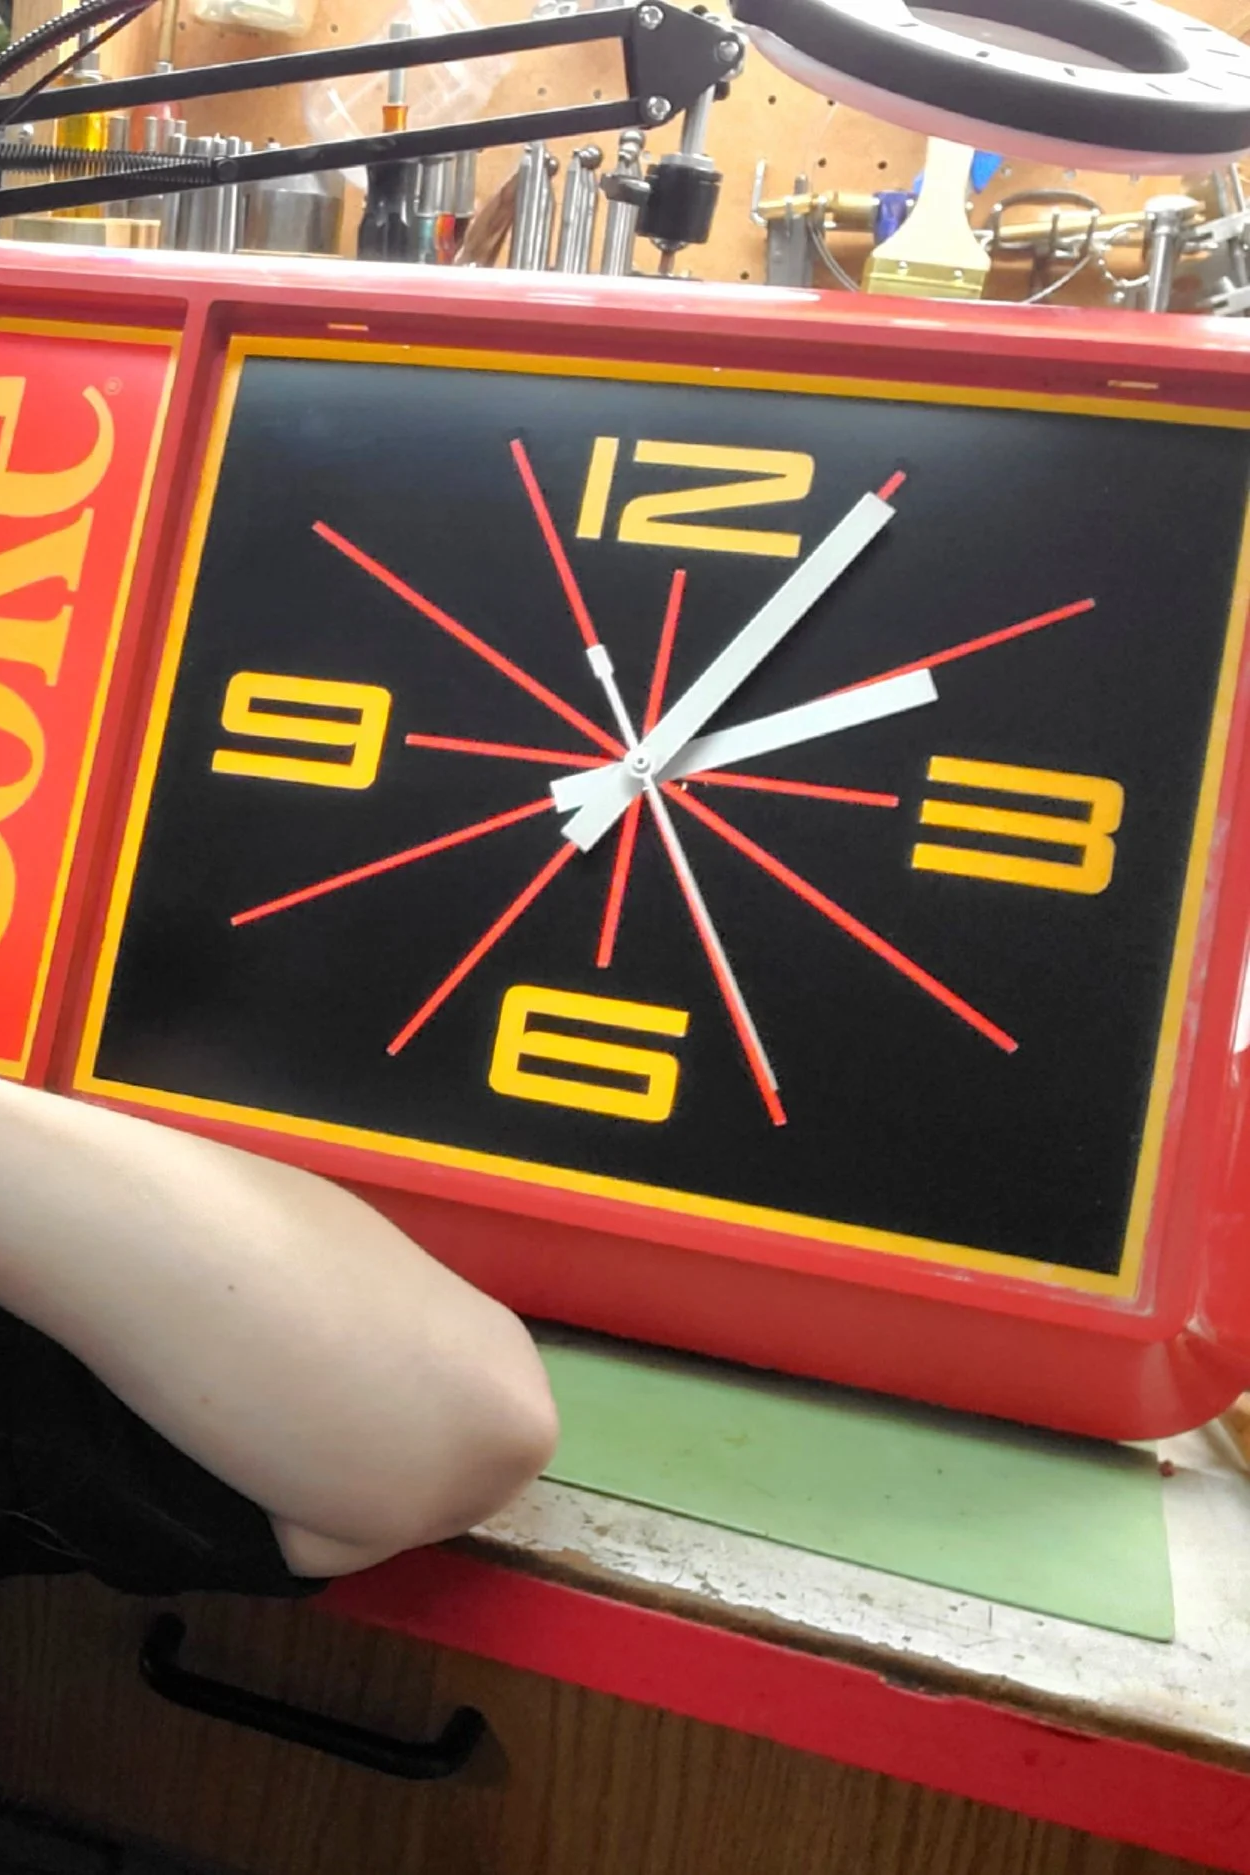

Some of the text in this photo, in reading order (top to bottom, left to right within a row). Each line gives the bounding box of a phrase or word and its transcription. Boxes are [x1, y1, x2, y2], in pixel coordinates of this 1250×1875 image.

[575, 438, 815, 558] 12
[211, 670, 393, 790] 9
[911, 755, 1124, 894] 3
[488, 984, 690, 1124] 6
